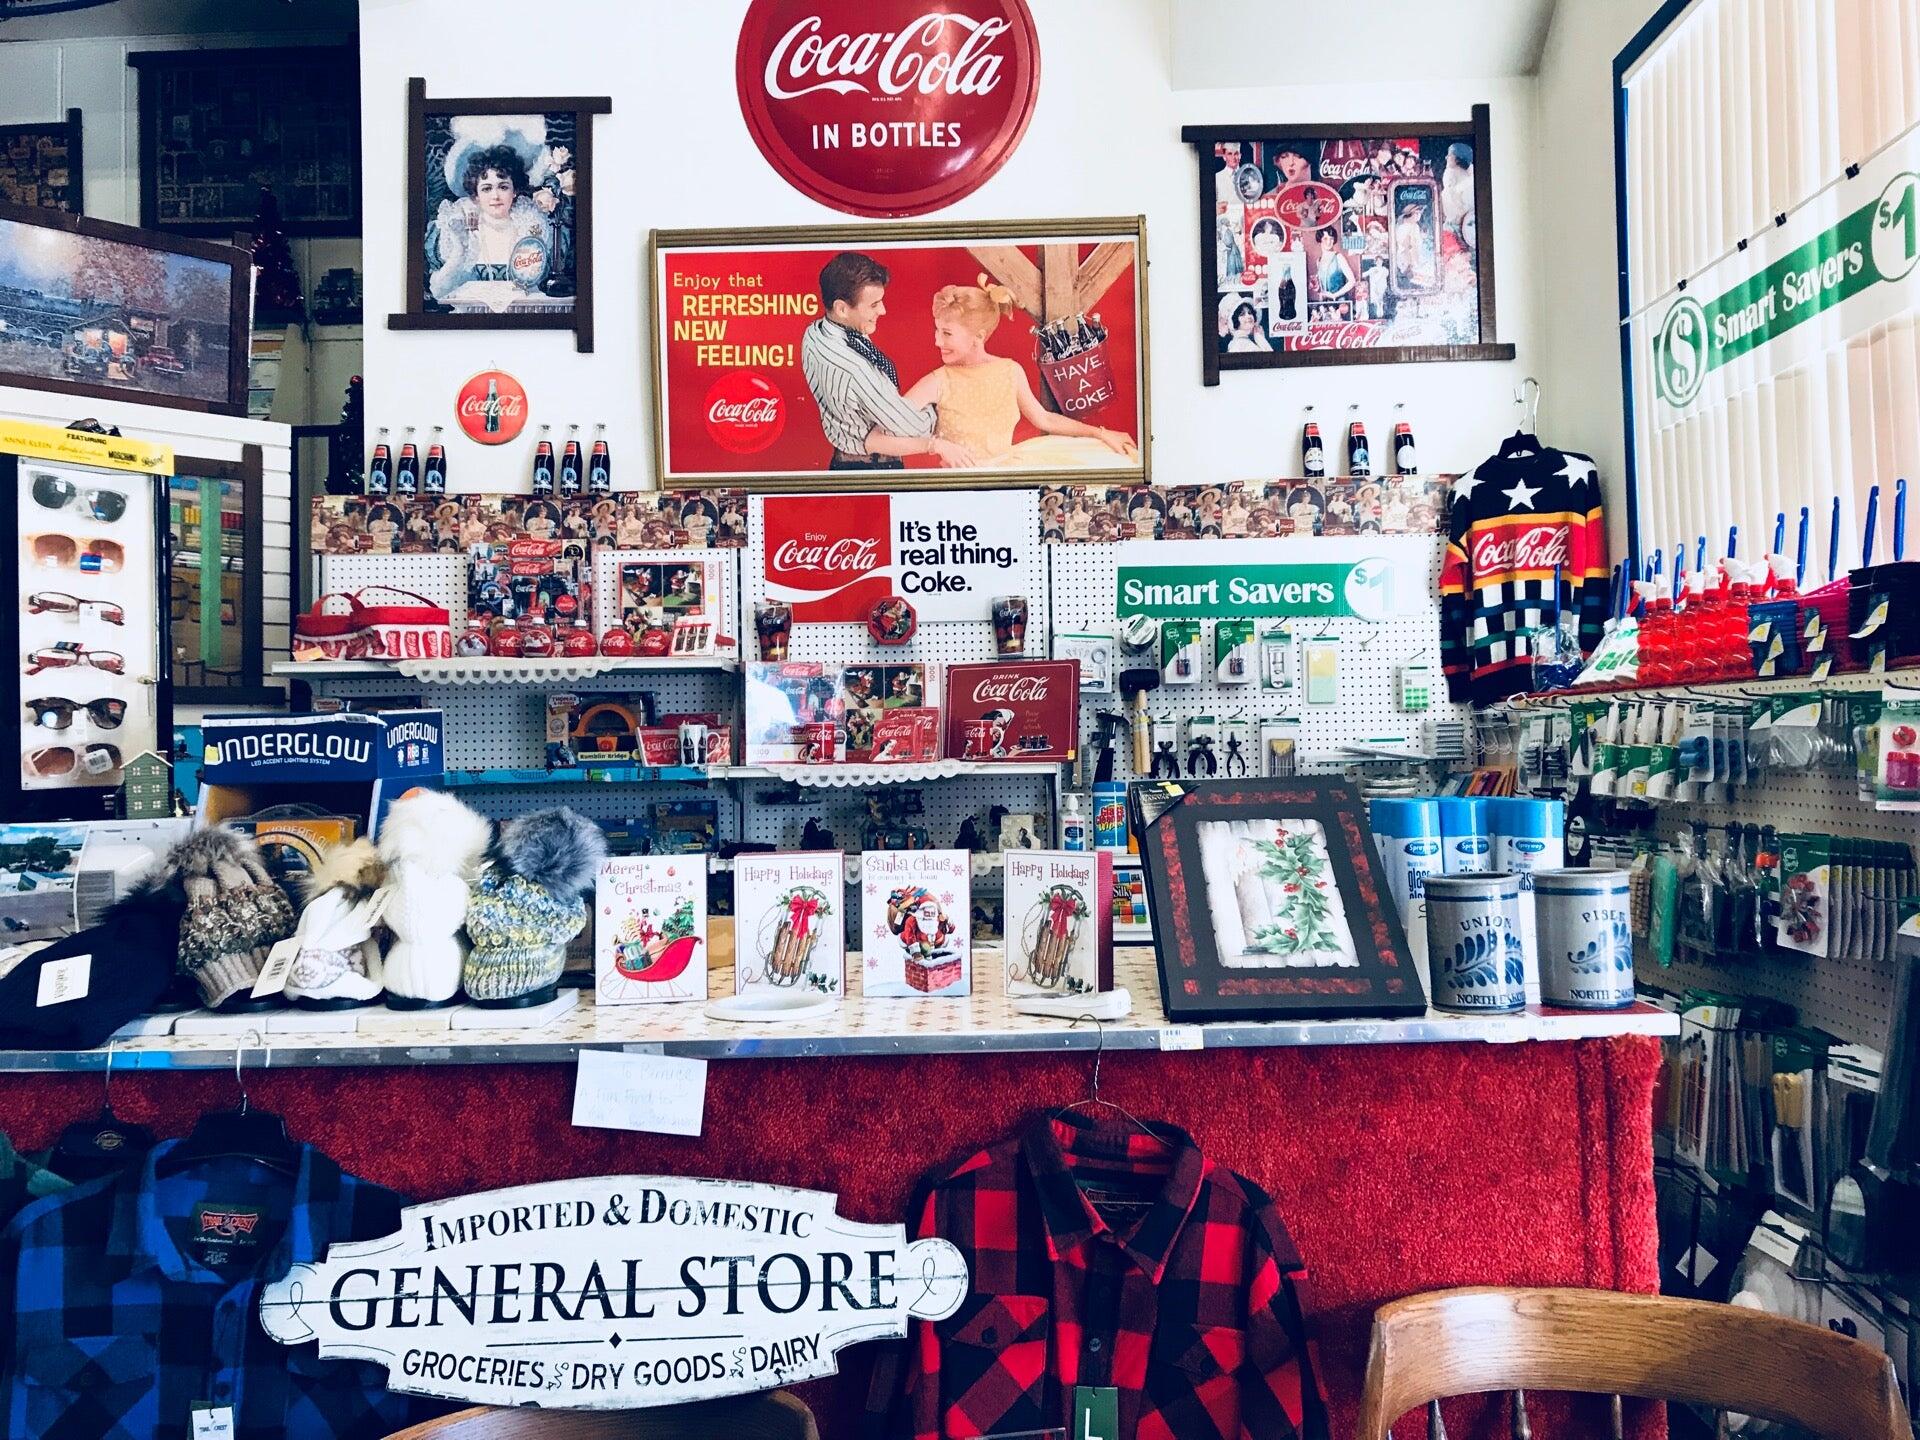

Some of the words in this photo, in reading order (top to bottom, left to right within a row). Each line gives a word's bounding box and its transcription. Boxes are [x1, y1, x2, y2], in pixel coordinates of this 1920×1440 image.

[764, 13, 1013, 100] Coca-Cola
[812, 123, 839, 150] IN
[851, 122, 961, 149] BOTTLES
[673, 272, 720, 290] Enjoy
[728, 272, 763, 288] that
[682, 293, 819, 317] REFRESHING
[1715, 284, 1777, 350] Smart
[1782, 241, 1863, 312] Savers
[673, 320, 727, 342] NEW
[697, 344, 795, 367] FEELING!
[1054, 354, 1102, 381] HAVE
[1065, 381, 1113, 411] COKE!
[1079, 378, 1092, 393] A
[461, 395, 523, 417] Coca-Cola
[708, 397, 780, 423] Coca-Cola
[66, 433, 107, 445] FEATURING
[805, 532, 827, 542] Enjoy
[900, 520, 931, 542] It's
[936, 520, 977, 542] the
[773, 538, 881, 572] Coca-Cola
[900, 543, 945, 566] real
[950, 542, 1018, 568] thing.
[1473, 525, 1569, 577] Coca-Cola
[901, 570, 972, 594] Coke.
[1124, 578, 1220, 607] Smart
[1228, 577, 1335, 605] Savers
[972, 676, 1050, 704] Coca-Cola
[387, 721, 438, 749] UNDERGLOW
[309, 758, 331, 766] SYSTEM
[600, 863, 644, 879] Merry
[866, 852, 908, 873] Santa
[913, 854, 951, 872] Claus
[1012, 861, 1043, 880] Happy
[1050, 862, 1090, 886] Holidays
[614, 878, 682, 896] Christmas
[744, 867, 780, 883] Happy
[790, 865, 834, 885] Holidays
[1460, 915, 1512, 931] UNION
[1456, 993, 1496, 1005] NORTH
[1570, 989, 1610, 1000] NORTH
[419, 1199, 596, 1253] IMPORTED
[602, 1193, 633, 1228] &
[639, 1187, 815, 1240] DOMESTIC
[329, 1259, 657, 1332] GENERAL
[677, 1249, 900, 1318] STORE
[402, 1348, 546, 1391] GROCERIES
[570, 1362, 623, 1393] DRY
[632, 1351, 727, 1388] GOODS
[750, 1331, 822, 1375] DAIRY
[1085, 1407, 1103, 1440] L
